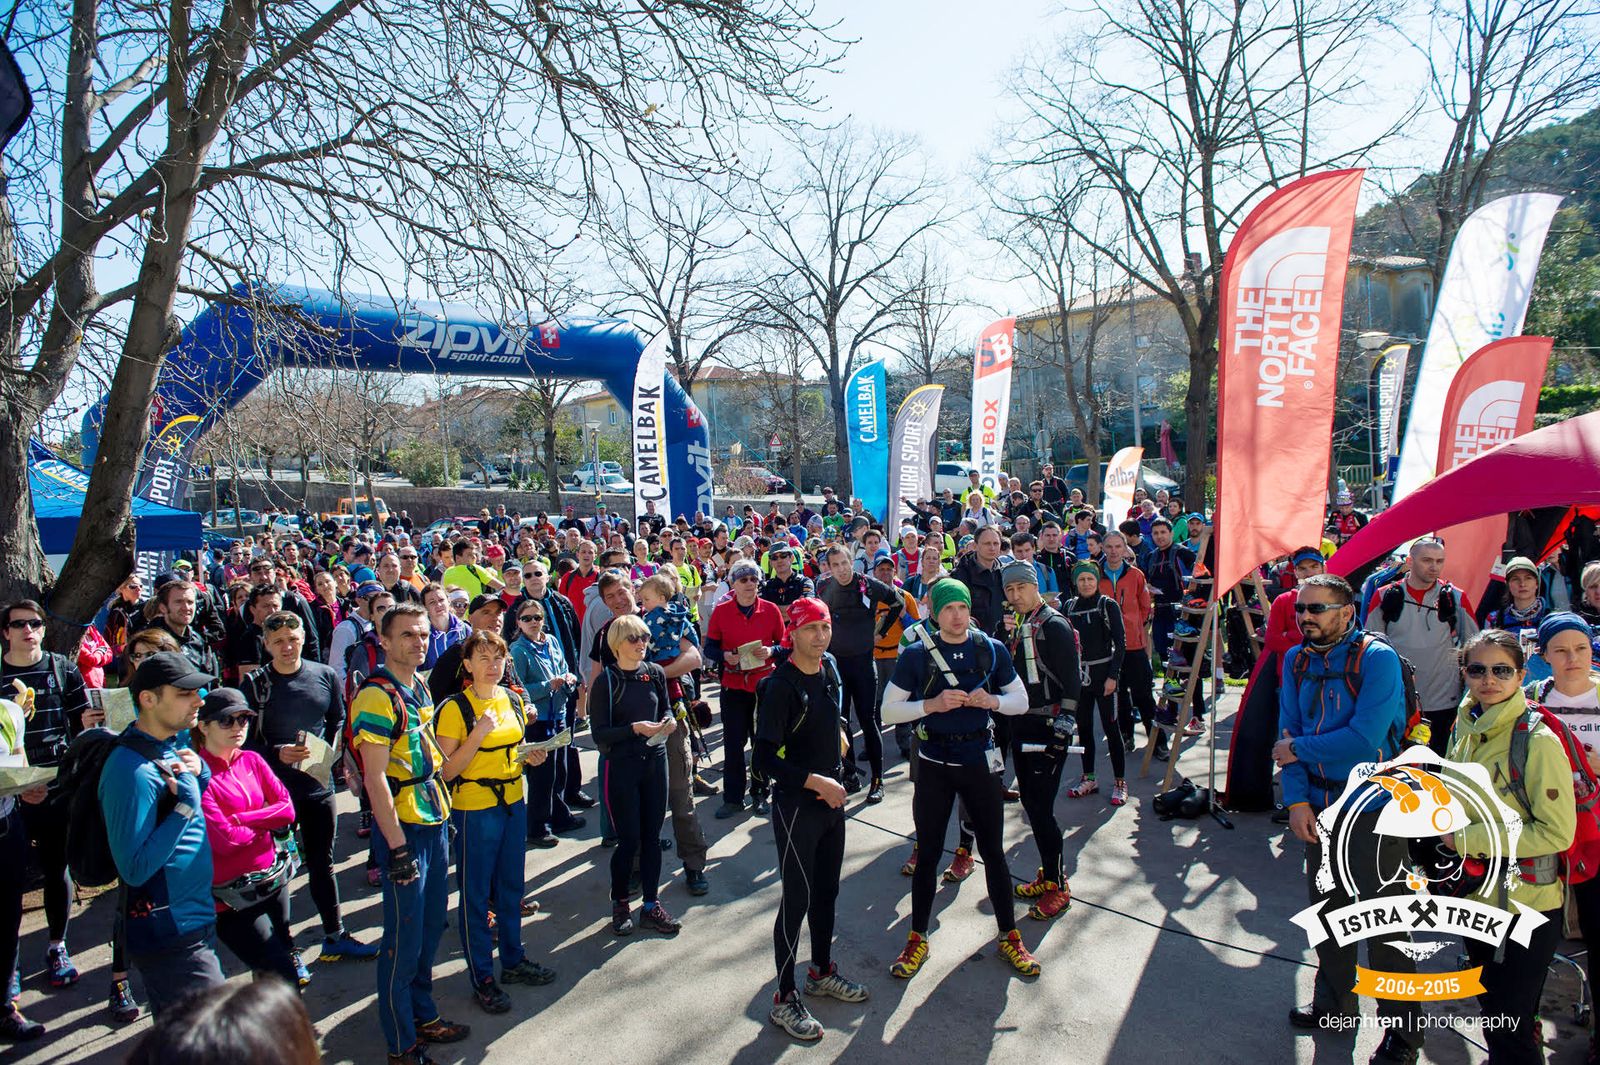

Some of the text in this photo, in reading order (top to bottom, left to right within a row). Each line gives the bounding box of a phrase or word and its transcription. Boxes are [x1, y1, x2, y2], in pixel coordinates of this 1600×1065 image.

[1234, 288, 1265, 355] THE
[1256, 289, 1293, 408] NORTH
[1287, 290, 1322, 377] FACE
[449, 352, 521, 364] sport.com
[637, 385, 667, 501] CAMELBAK
[857, 375, 878, 443] CAMELBAK
[902, 419, 921, 462] SPORT
[34, 459, 91, 491] CAMEL
[982, 400, 998, 489] ORTBOX
[687, 440, 713, 518] pvit
[1580, 723, 1592, 731] all
